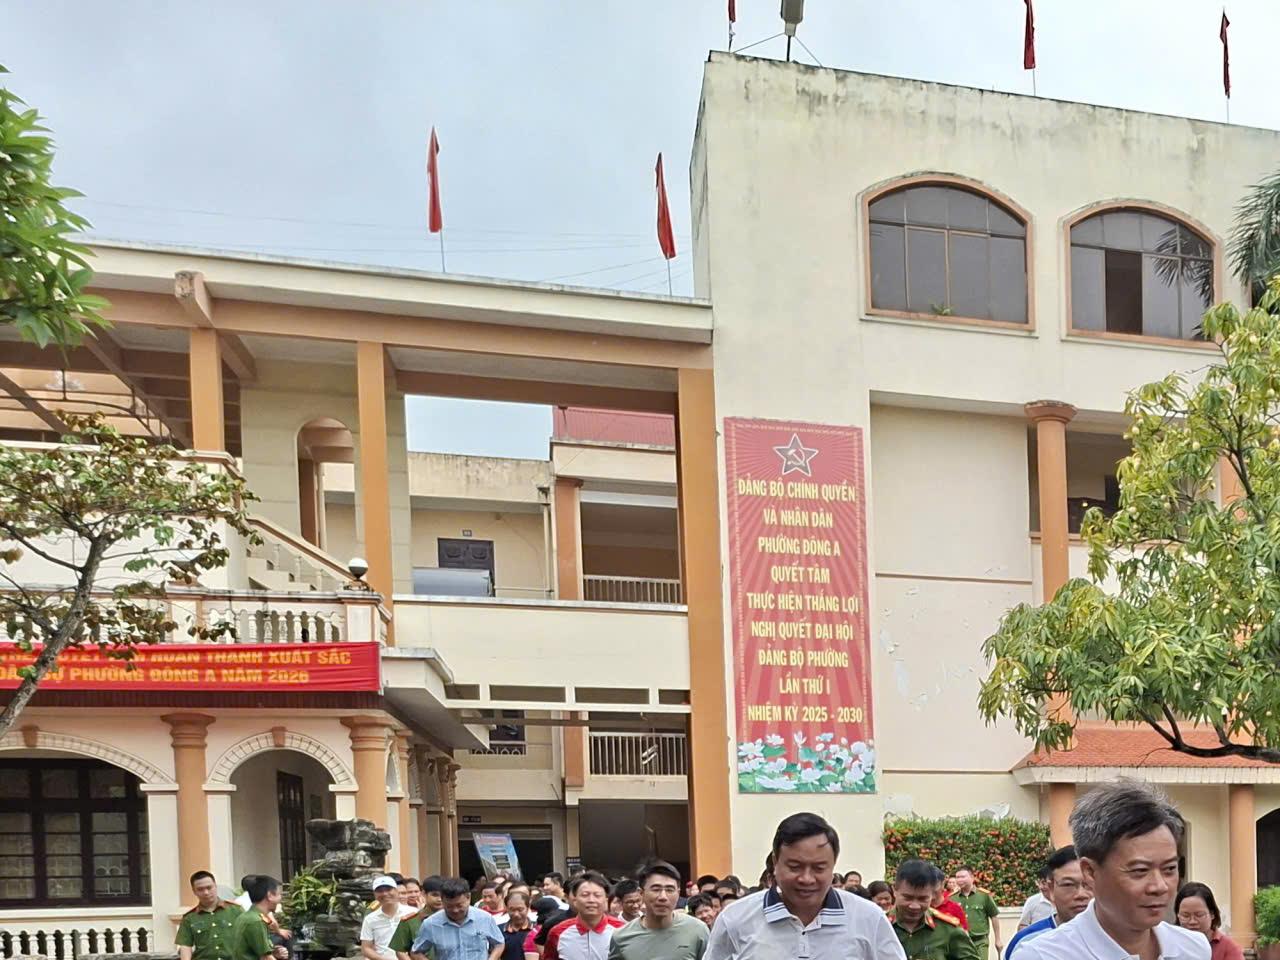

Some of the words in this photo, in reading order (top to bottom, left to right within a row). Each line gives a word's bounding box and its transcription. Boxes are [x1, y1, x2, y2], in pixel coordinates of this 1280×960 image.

[738, 473, 767, 496] ĐẢNG
[770, 477, 784, 500] BỘ
[787, 479, 818, 499] CHÍNH
[821, 479, 856, 502] QUYỀN
[763, 505, 777, 525] VÀ
[781, 507, 808, 526] NHÂN
[812, 508, 833, 528] DÂN
[758, 533, 800, 554] PHƯỜNG
[803, 535, 831, 556] ĐÔNG
[833, 541, 840, 556] A
[771, 560, 804, 584] QUYẾT
[807, 563, 830, 584] TÂM
[746, 591, 775, 612] THỰC
[778, 590, 802, 613] HIỆN
[805, 589, 839, 612] THẮNG
[842, 595, 859, 615] LỢI
[751, 621, 775, 640] NGHỊ
[779, 617, 812, 640] QUYẾT
[815, 623, 833, 642] ĐẠI
[836, 620, 853, 643] HỘI
[758, 643, 787, 666] ĐẢNG
[790, 647, 804, 669] BỘ
[808, 648, 848, 668] PHƯỜNG
[205, 669, 216, 682] A
[780, 672, 800, 694] LẦN
[802, 675, 824, 694] THỨ
[826, 679, 830, 695] I
[748, 702, 782, 724] NHIỆM
[784, 703, 798, 721] KỲ
[802, 706, 828, 722] 2025
[837, 706, 863, 723] 2030
